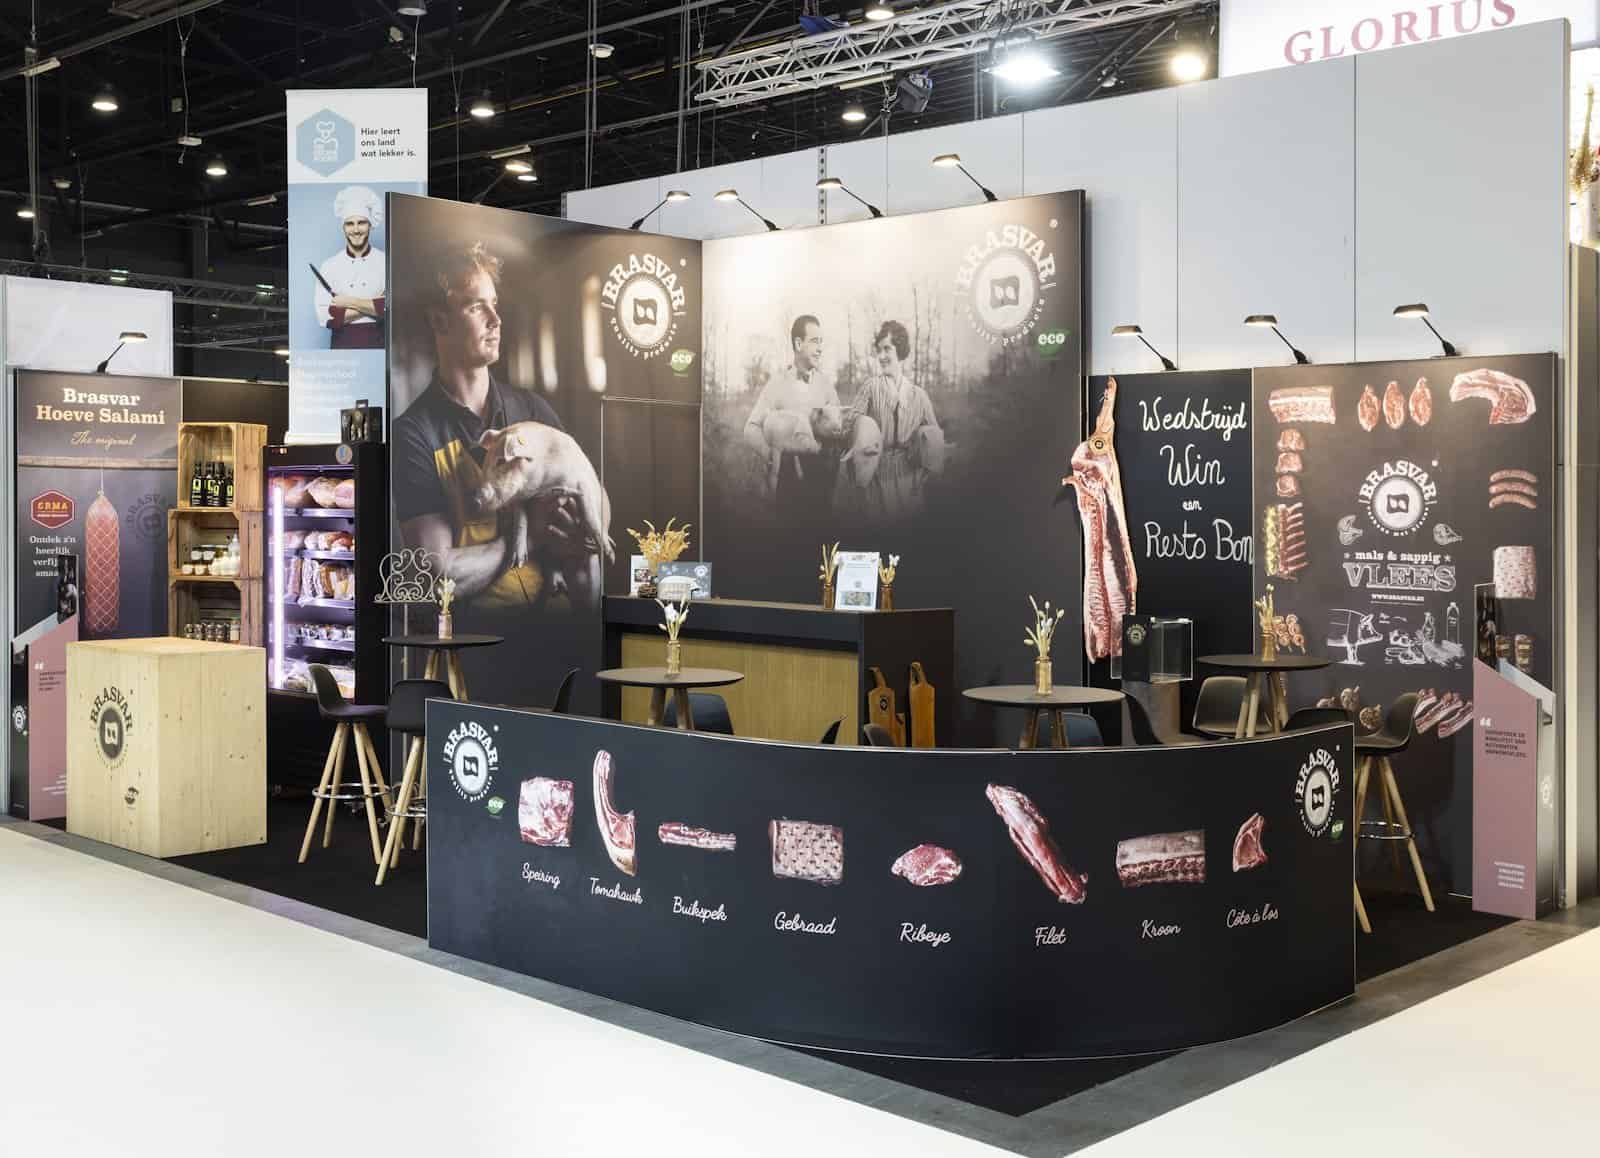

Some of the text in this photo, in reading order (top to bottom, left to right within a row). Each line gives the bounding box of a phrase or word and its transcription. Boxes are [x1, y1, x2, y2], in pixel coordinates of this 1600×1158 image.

[1284, 0, 1516, 64] GLORIUS
[360, 127, 401, 136] Hier leert
[360, 137, 396, 147] ons land
[360, 150, 377, 158] wat
[379, 149, 405, 157] lekker
[957, 224, 1057, 288] BRASVAR
[602, 253, 685, 311] BRASVAR
[1038, 333, 1066, 345] eco
[671, 351, 693, 365] eco
[63, 387, 141, 406] Brasvar
[35, 404, 166, 425] Hoeve Salami
[1159, 443, 1226, 487] Win
[1358, 460, 1438, 501] BRASVAR
[1144, 518, 1254, 565] Resto Bon
[1355, 550, 1442, 565] mals & sappig
[1342, 562, 1457, 592] VLEES
[90, 686, 133, 732] BRASVAR
[443, 721, 499, 767] BRASVAR
[1295, 748, 1340, 798] BRASVAR
[590, 877, 644, 905] Tomahawk
[672, 896, 728, 923] Buikspek
[774, 911, 837, 935] Gebraad
[900, 922, 952, 947] Ribeye
[1035, 926, 1067, 946] Filet
[1141, 920, 1181, 939] Kroon
